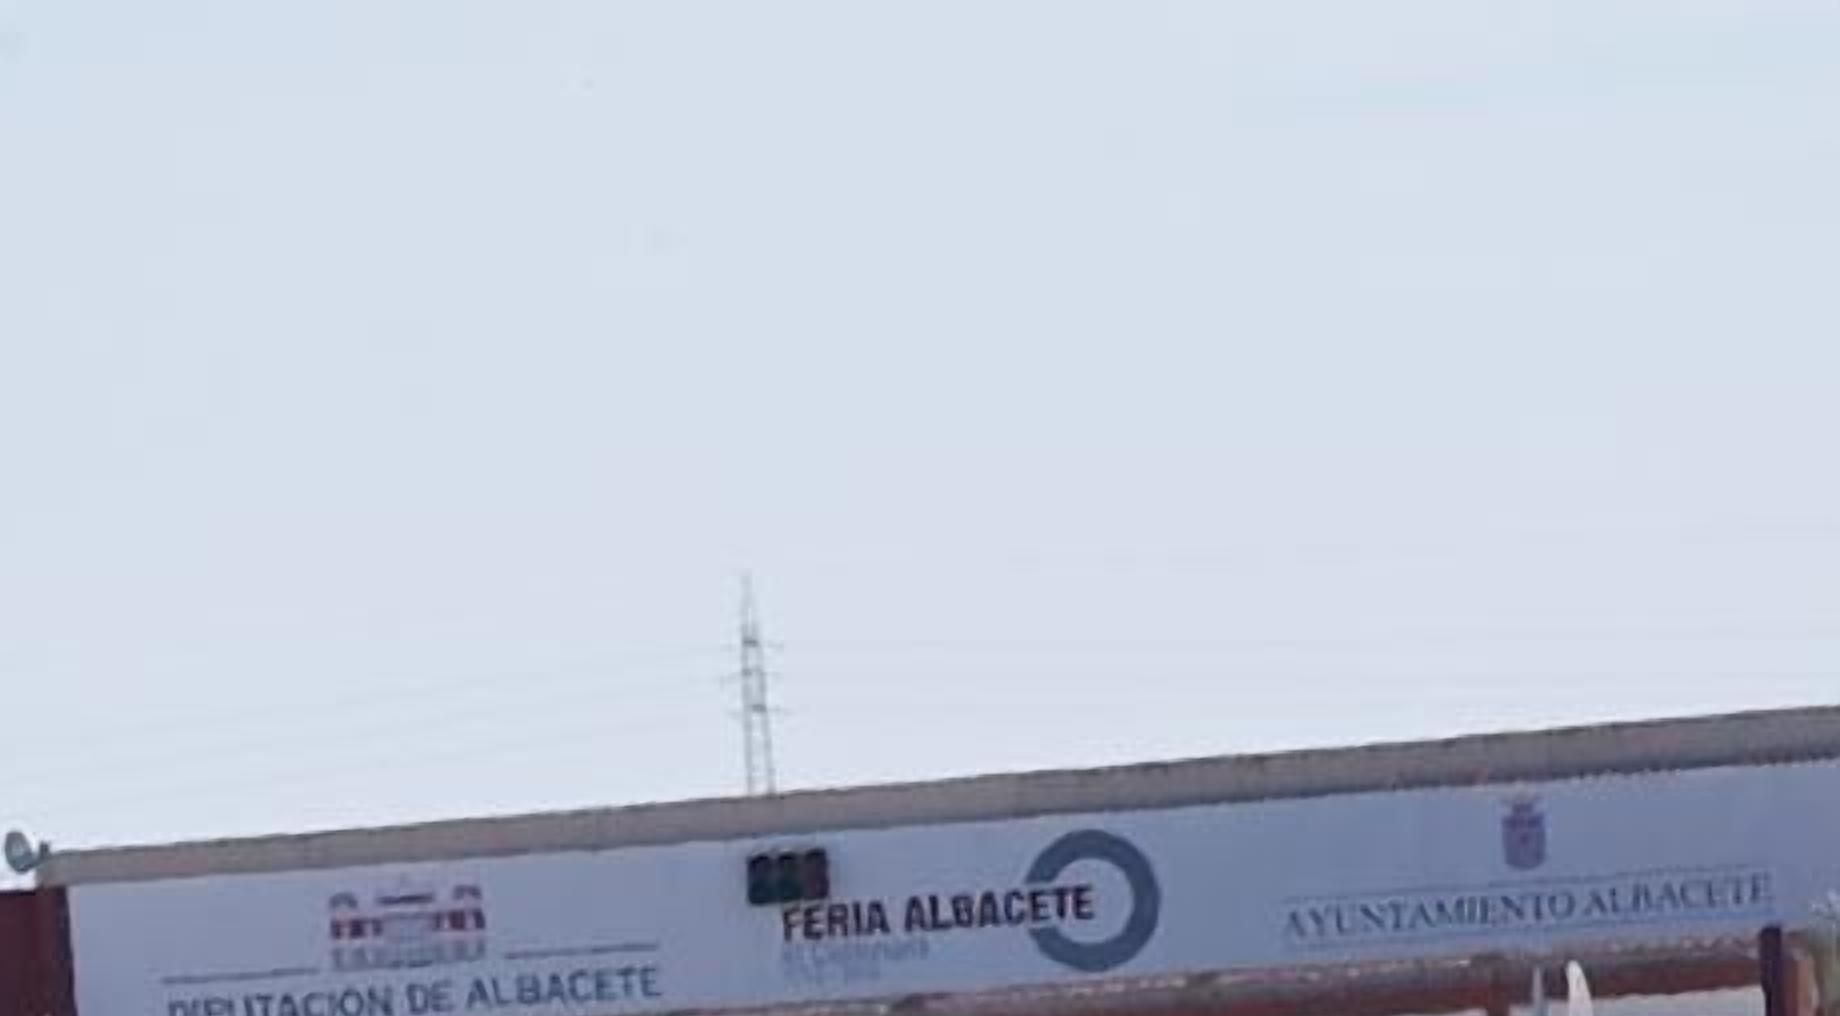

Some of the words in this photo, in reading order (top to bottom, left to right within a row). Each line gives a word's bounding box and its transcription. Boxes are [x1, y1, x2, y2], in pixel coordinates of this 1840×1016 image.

[782, 900, 890, 942] FERIA
[904, 883, 1095, 931] ALBACETE
[1282, 894, 1576, 940] AYUNTAMIENTO
[407, 981, 452, 1013] DE
[466, 966, 662, 1008] ALBACETE
